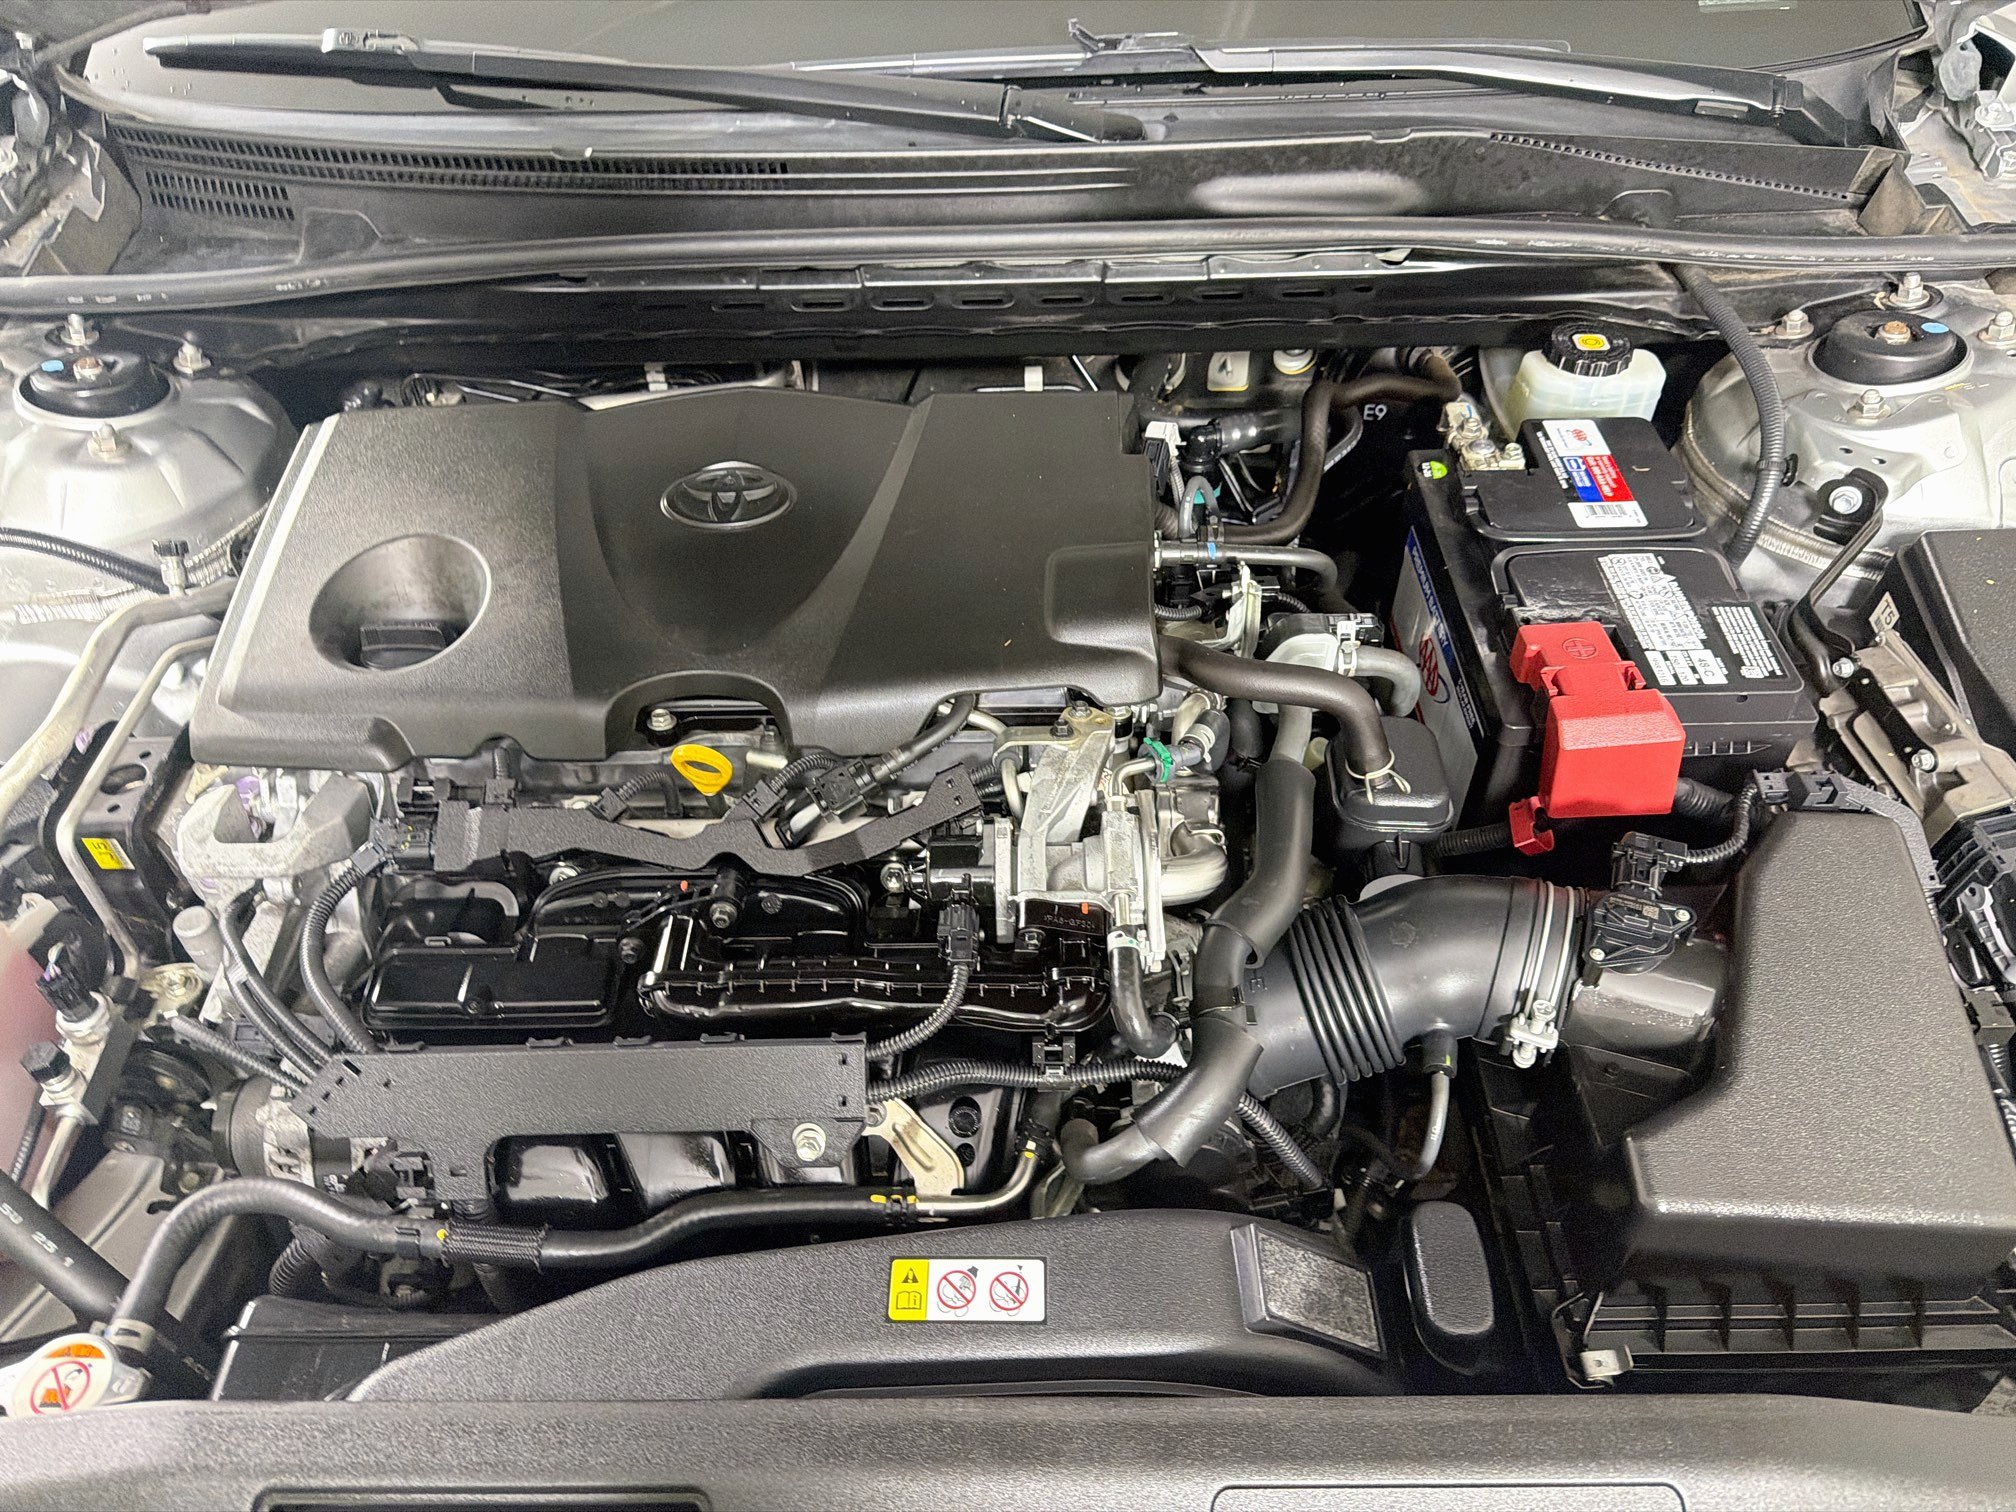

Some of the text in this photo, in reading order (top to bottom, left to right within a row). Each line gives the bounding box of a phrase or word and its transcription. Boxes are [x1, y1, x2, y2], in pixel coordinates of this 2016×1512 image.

[1363, 403, 1388, 421] E9
[1881, 598, 1896, 626] T5
[31, 1231, 59, 1254] 25
